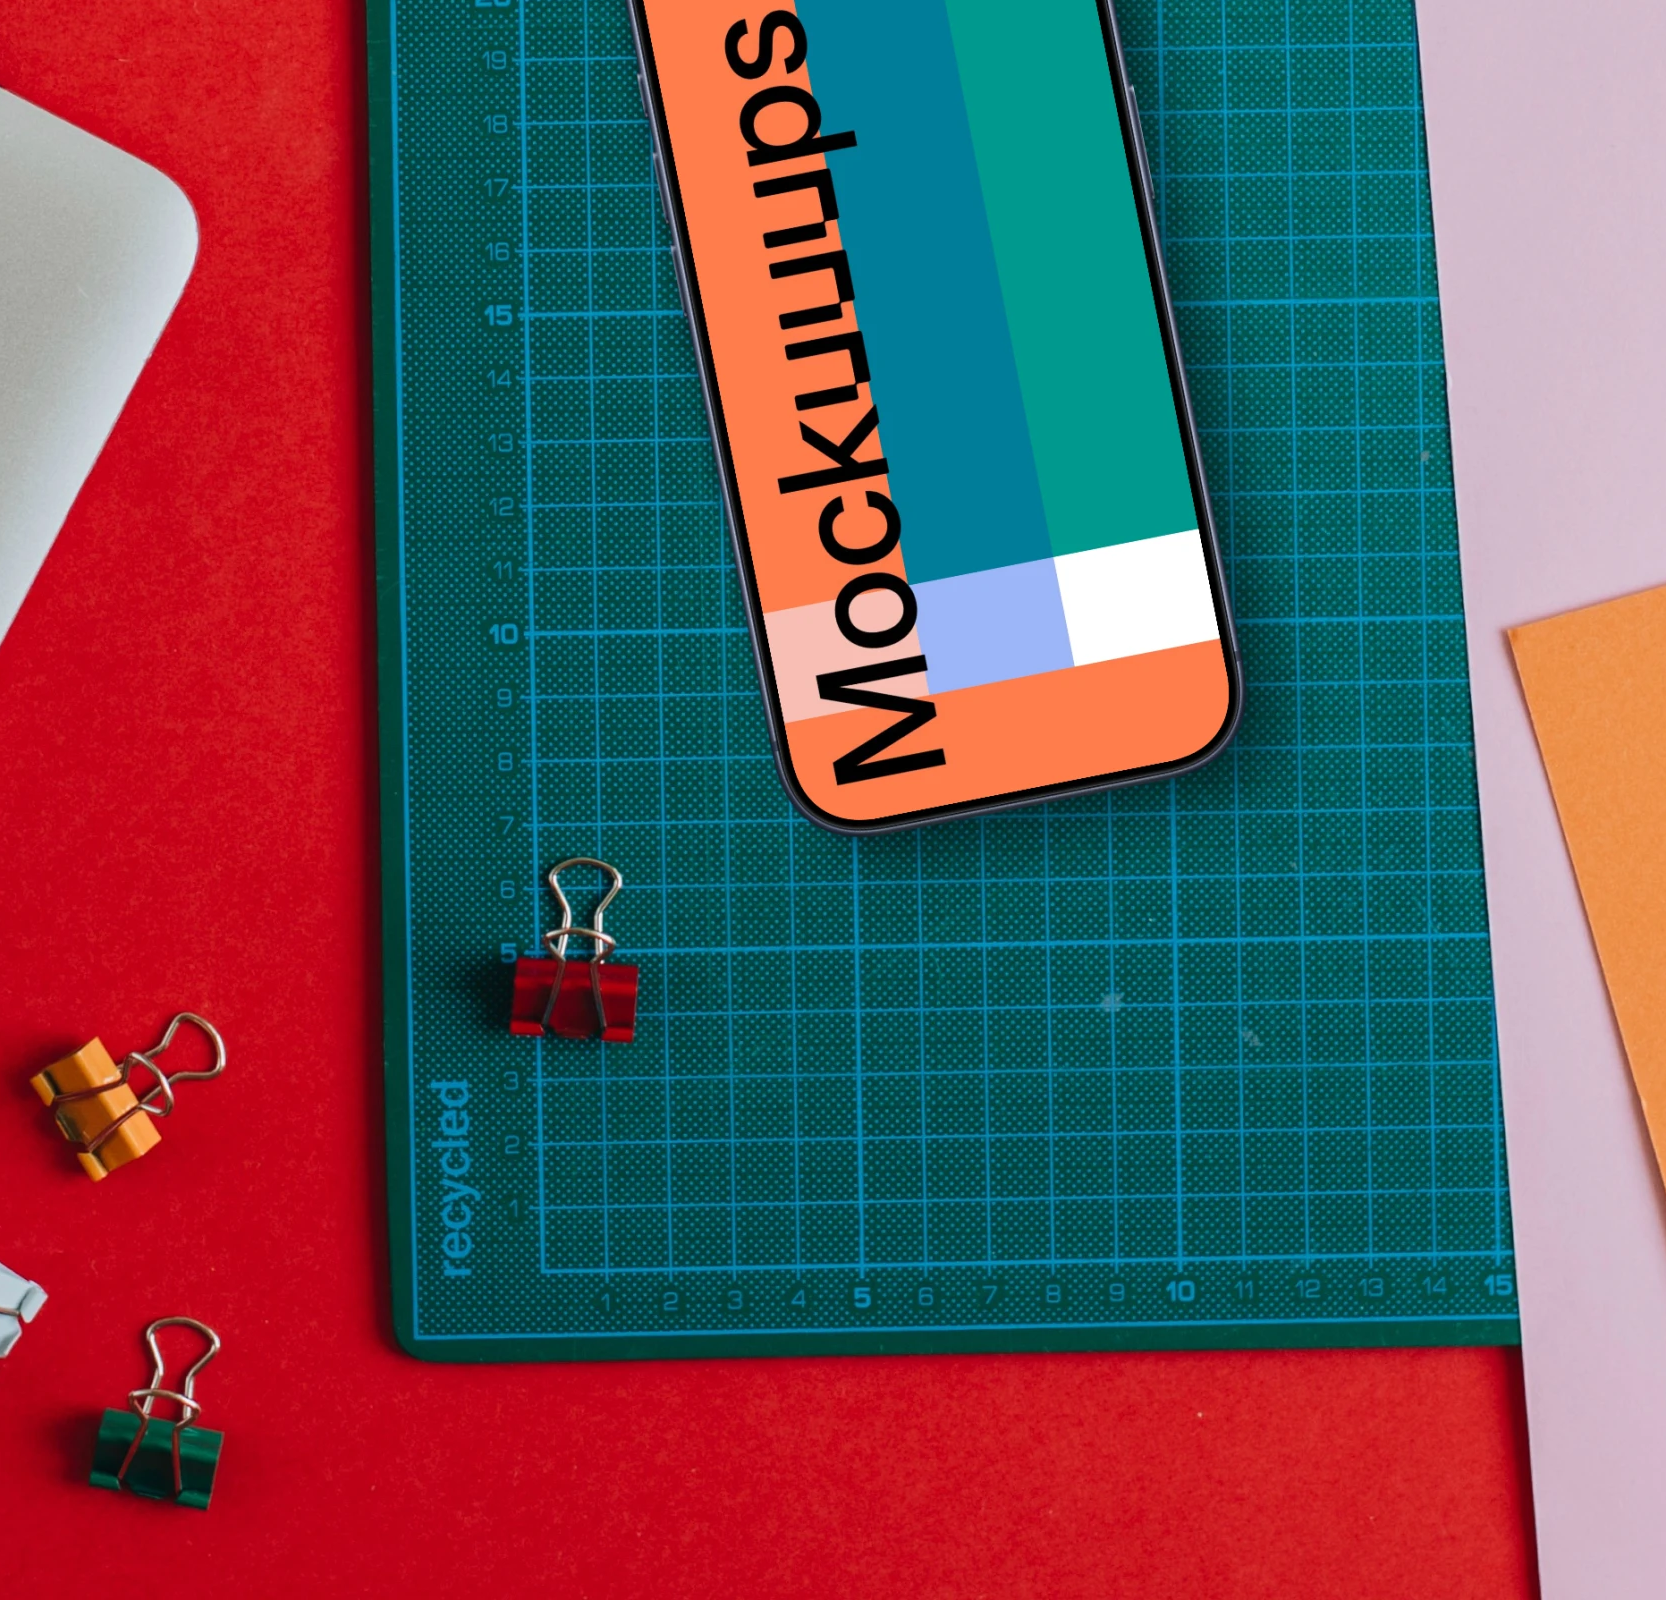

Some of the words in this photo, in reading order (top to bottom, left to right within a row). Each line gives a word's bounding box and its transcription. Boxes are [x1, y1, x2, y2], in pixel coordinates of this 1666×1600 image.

[481, 51, 507, 71] 19
[483, 114, 508, 134] 18
[483, 178, 509, 198] 17
[485, 242, 509, 262] 16
[484, 305, 513, 326] 15
[486, 369, 512, 389] 14
[724, 9, 947, 787] Mockuuups
[488, 433, 514, 453] 13
[488, 497, 514, 517] 12
[492, 560, 512, 580] 11
[489, 624, 518, 645] 10
[497, 687, 513, 708] 9
[498, 752, 514, 772] 8
[498, 817, 514, 836] 7
[500, 881, 516, 900] 6
[500, 942, 517, 964] 5
[504, 1072, 519, 1091] 3
[505, 1135, 521, 1155] 2
[431, 1079, 481, 1277] recycled
[509, 1199, 519, 1218] 1
[601, 1293, 612, 1313] 1
[663, 1292, 679, 1311] 2
[727, 1292, 743, 1311] 3
[791, 1290, 807, 1309] 4
[853, 1288, 872, 1309] 5
[918, 1287, 934, 1307] 6
[982, 1286, 998, 1305] 7
[1045, 1285, 1061, 1304] 8
[1109, 1283, 1125, 1303] 9
[1166, 1280, 1195, 1301] 10
[1235, 1280, 1255, 1299] 11
[1295, 1279, 1321, 1298] 12
[1359, 1278, 1384, 1297] 13
[1422, 1277, 1447, 1295] 14
[1485, 1274, 1513, 1296] 15
